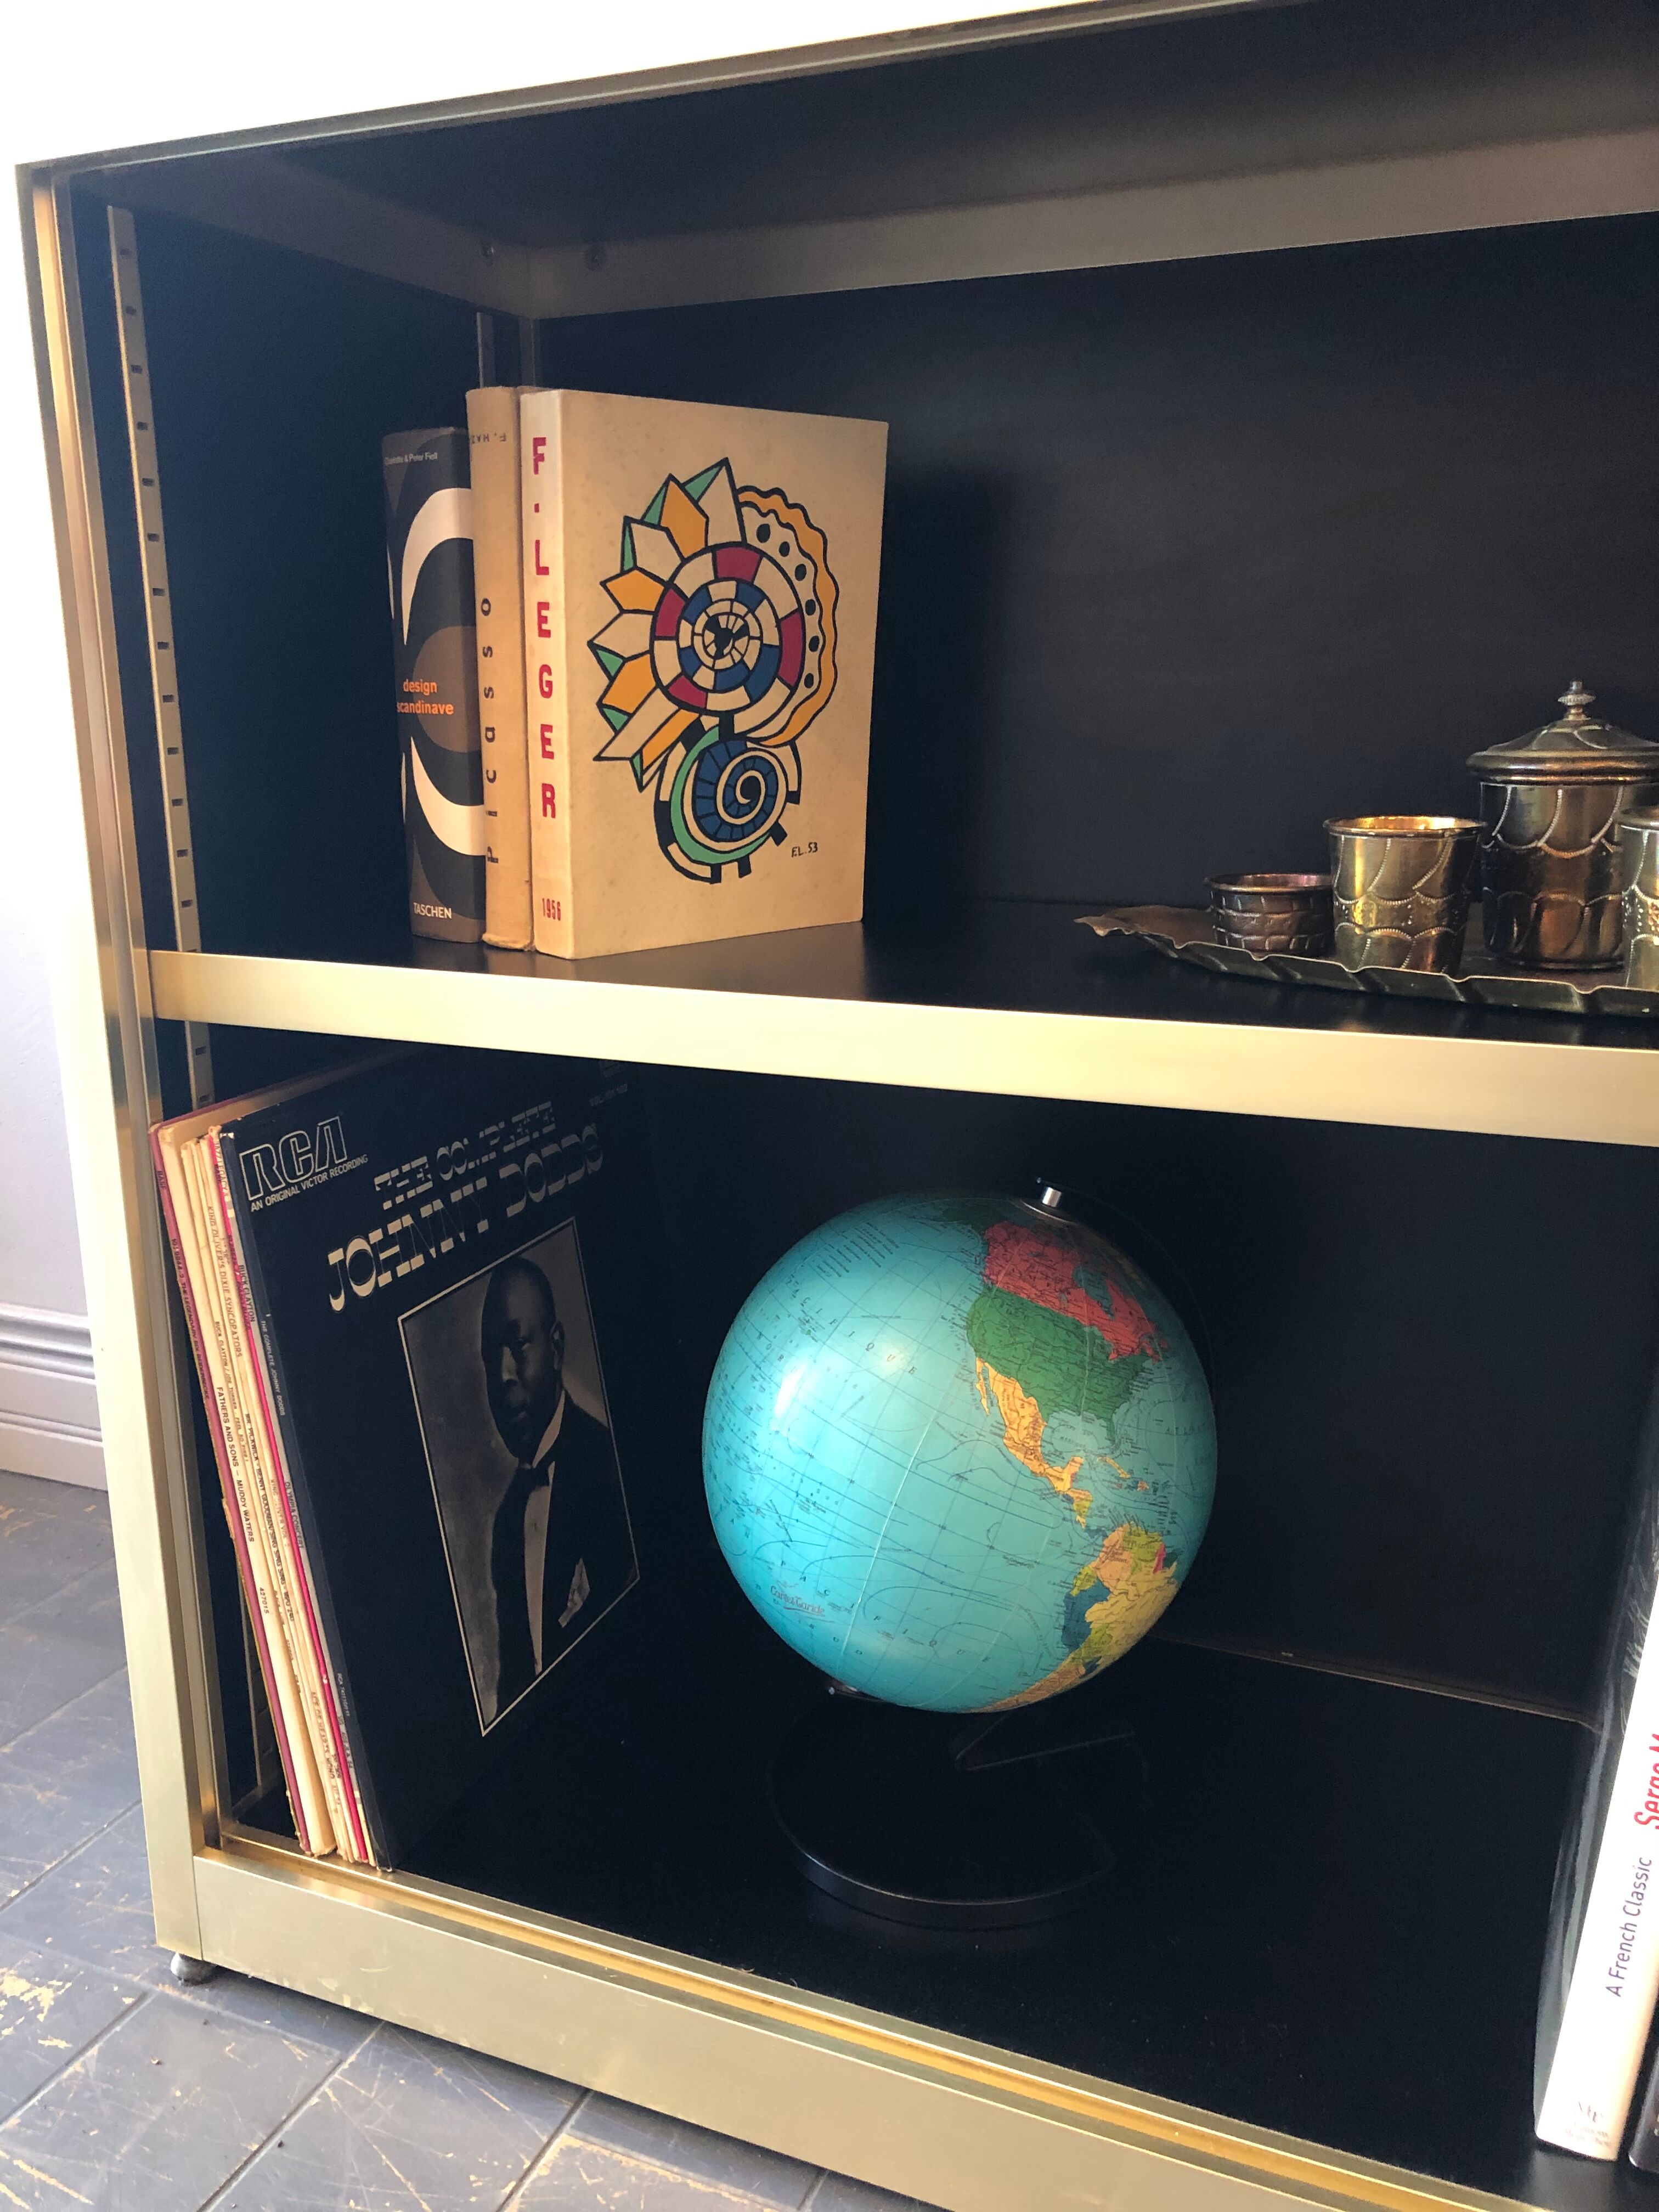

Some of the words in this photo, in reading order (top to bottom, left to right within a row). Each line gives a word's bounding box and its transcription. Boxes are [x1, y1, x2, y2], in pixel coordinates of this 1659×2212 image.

[403, 679, 438, 697] design
[397, 700, 454, 715] scandinave
[413, 901, 452, 920] TASCHEN
[541, 898, 562, 922] 1956
[239, 1115, 348, 1201] RCA
[251, 1199, 264, 1212] AN
[264, 1184, 301, 1206] ORIGINAL
[301, 1171, 329, 1190] VICTOR
[330, 1154, 369, 1178] RECORDING
[374, 1155, 434, 1210] THE
[206, 1206, 217, 1226] KING
[328, 1176, 490, 1313] JOHNNY
[498, 1122, 604, 1218] DODDS
[211, 1229, 225, 1268] OLIVER'S
[219, 1271, 230, 1293] DIXIE
[238, 1265, 249, 1284] BUCK
[242, 1287, 256, 1322] CLAYTON
[215, 1321, 223, 1336] BUCK
[224, 1297, 243, 1357] SYNCOPATORS
[259, 1321, 268, 1331] THE
[218, 1340, 228, 1366] CLAYTON
[263, 1334, 275, 1365] COMPLETE
[270, 1368, 281, 1392] JOHNNY
[216, 1386, 230, 1423] FATHERS
[276, 1395, 285, 1415] DODDS
[224, 1425, 234, 1442] AND
[228, 1443, 239, 1467] SONS
[255, 1468, 266, 1491] BENNY
[236, 1480, 247, 1508] MUDDY
[242, 1509, 255, 1542] WATERS
[284, 1481, 297, 1513] OLYMPIA
[291, 1515, 304, 1548] CONCERT
[258, 1587, 269, 1614] 427015
[1622, 1855, 1652, 1917] Classic
[1609, 1921, 1638, 1980] French
[1606, 1984, 1622, 1997] A
